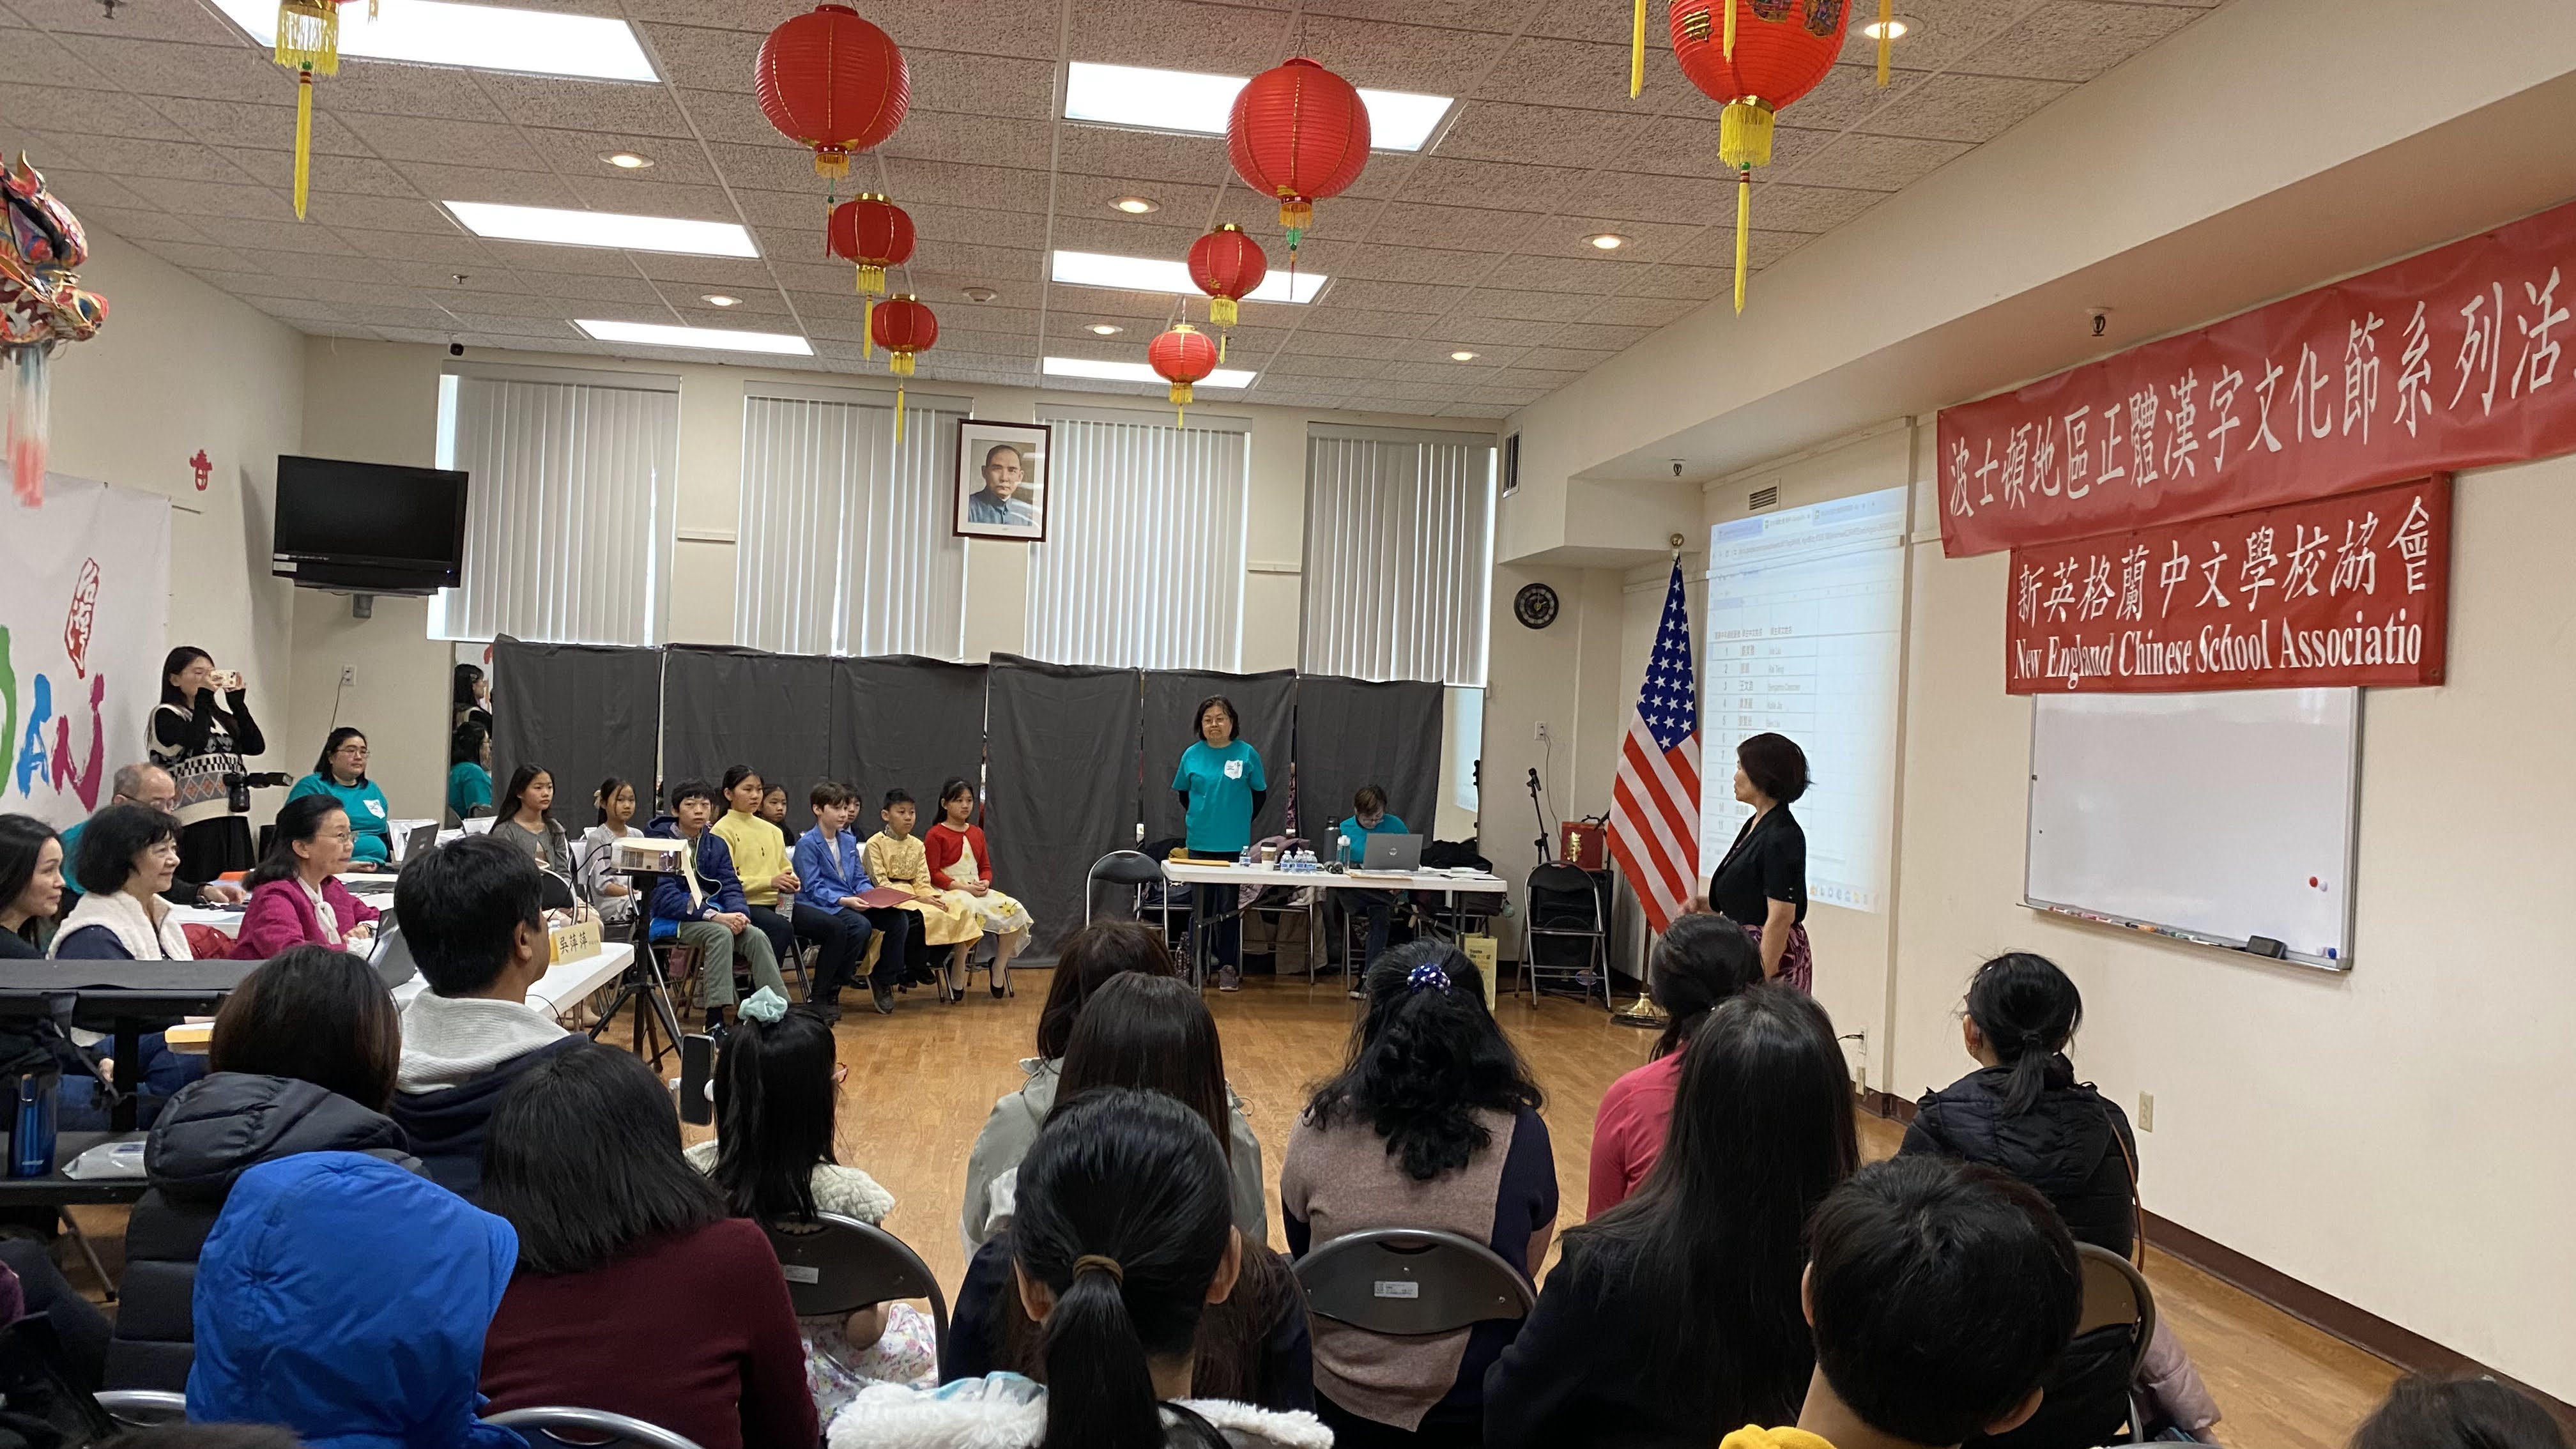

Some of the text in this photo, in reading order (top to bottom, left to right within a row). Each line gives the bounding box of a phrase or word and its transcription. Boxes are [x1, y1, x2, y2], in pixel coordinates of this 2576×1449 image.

[1949, 266, 2576, 518] 波士頓地區正體漢字文化節系列活
[2016, 495, 2430, 627] 新英格蘭中文學校協會
[2014, 608, 2422, 689] New England Chinese School Associatio
